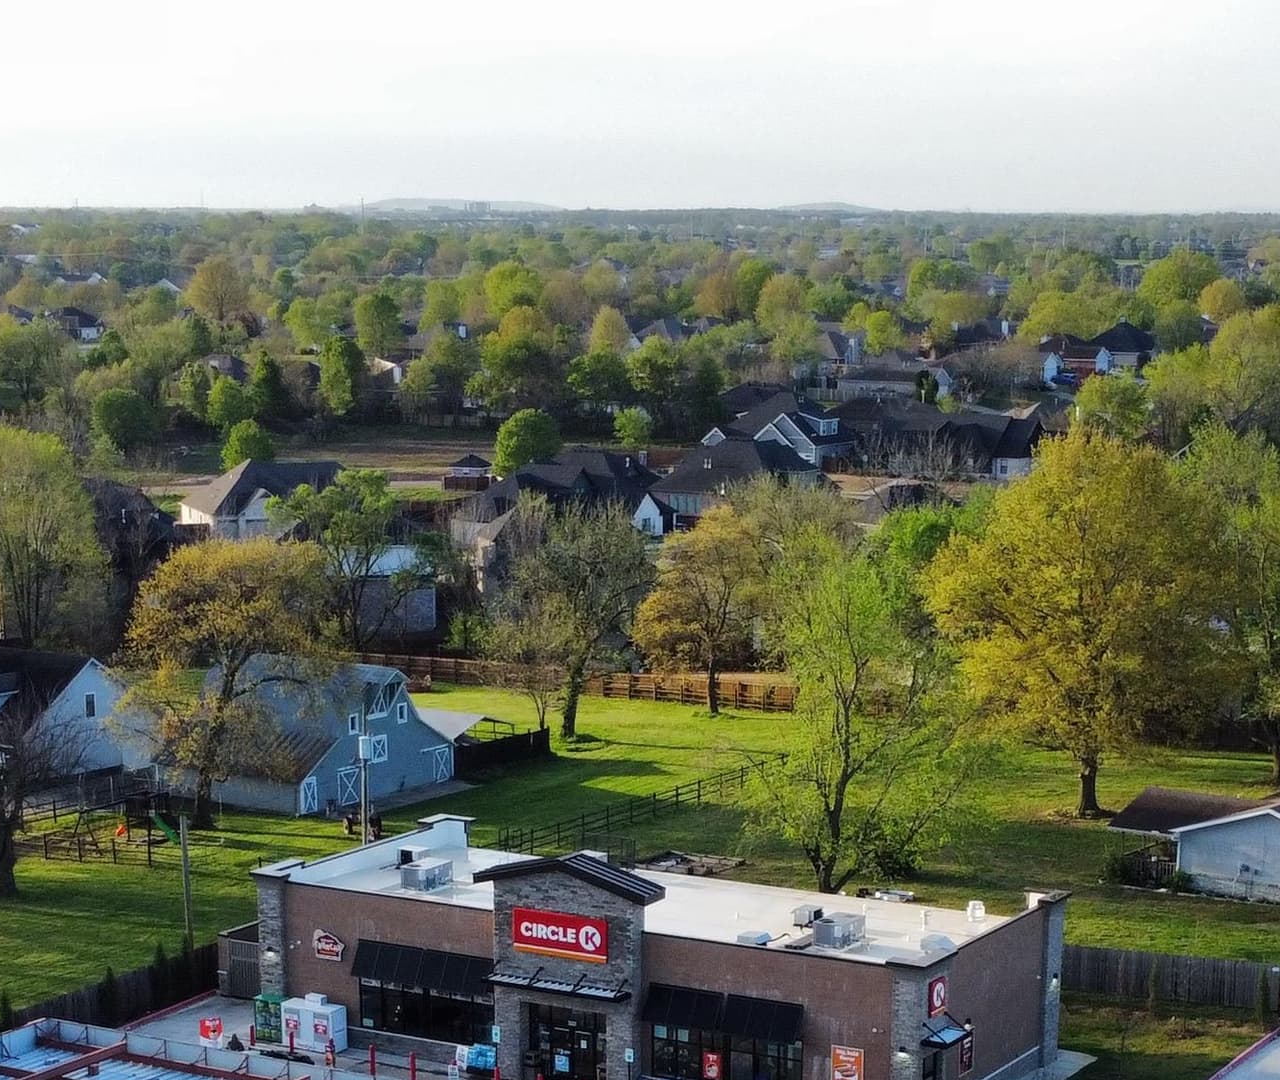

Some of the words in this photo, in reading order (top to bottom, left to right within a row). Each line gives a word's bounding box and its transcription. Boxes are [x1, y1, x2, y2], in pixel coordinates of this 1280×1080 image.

[520, 921, 577, 943] CIRCLE
[582, 927, 601, 950] K
[934, 984, 945, 1006] K
